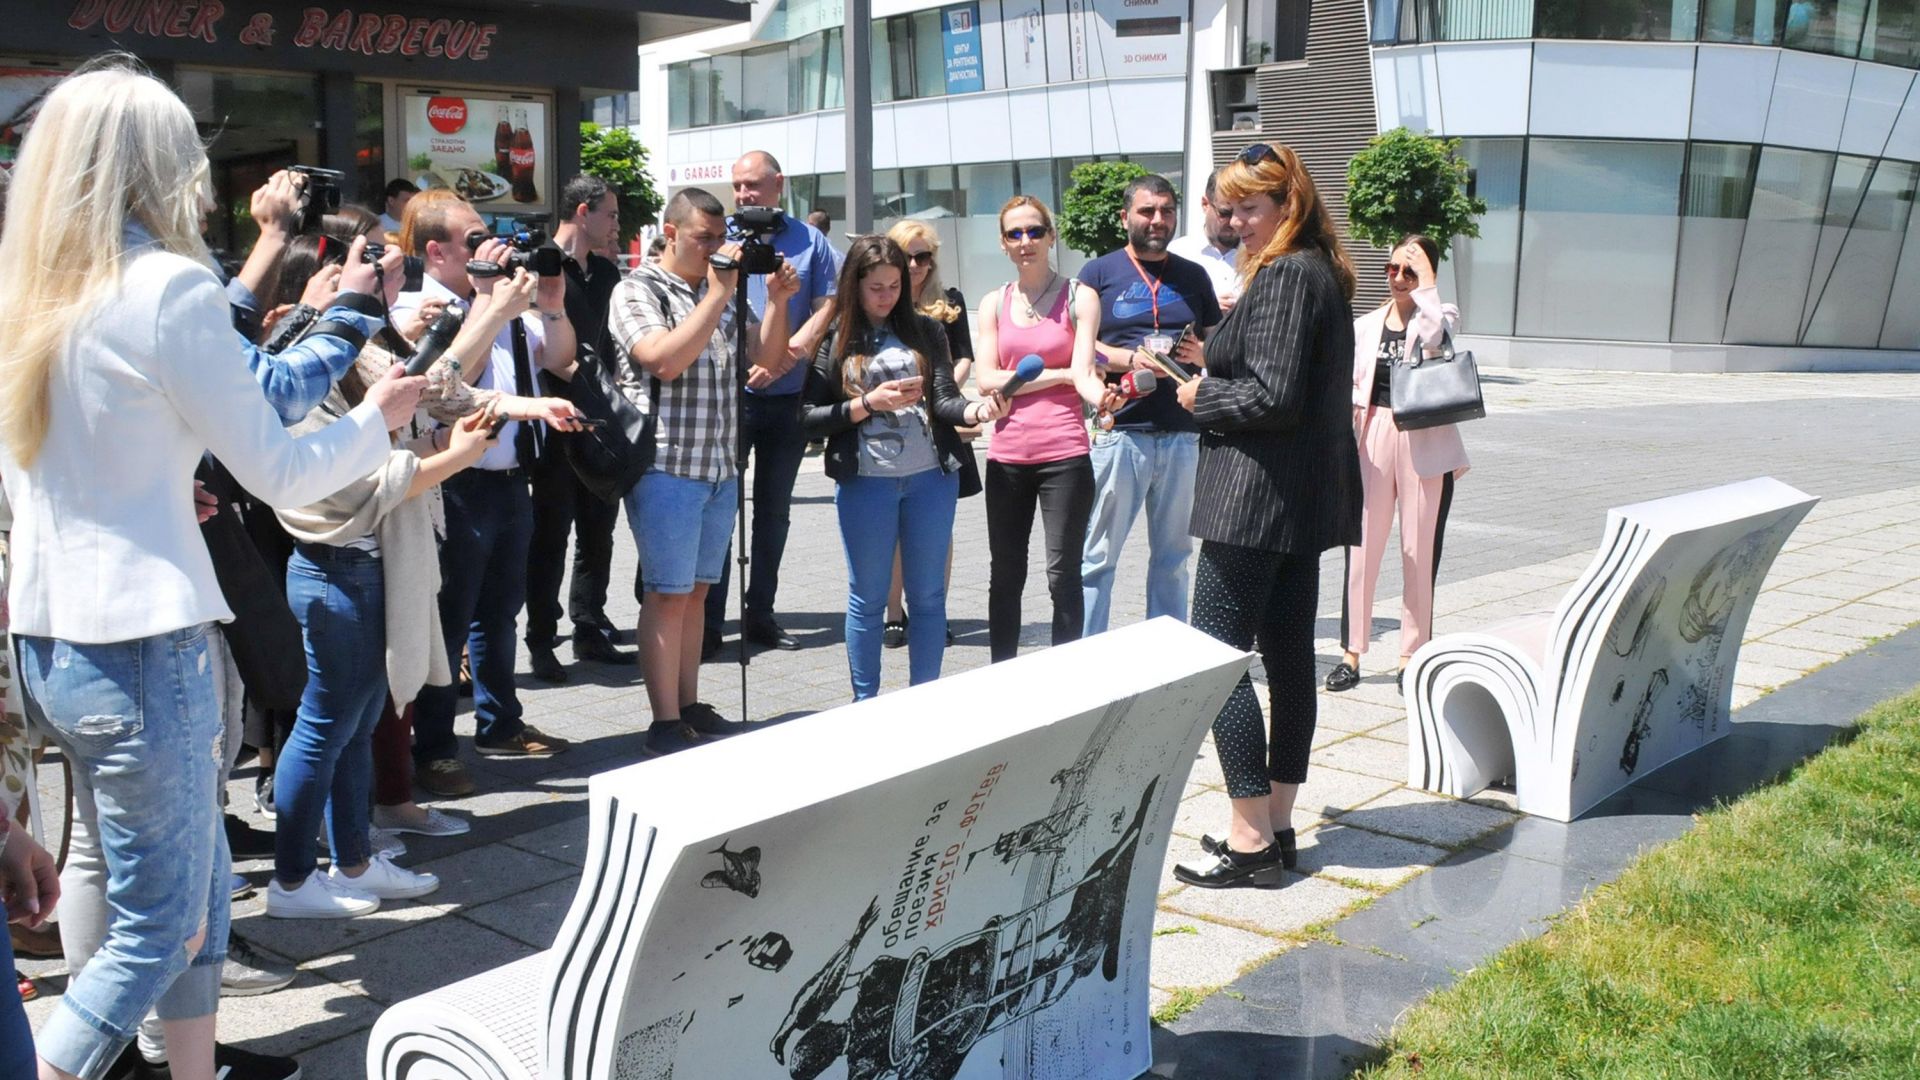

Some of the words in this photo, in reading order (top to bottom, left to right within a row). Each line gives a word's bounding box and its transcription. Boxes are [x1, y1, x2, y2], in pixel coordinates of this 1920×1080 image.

[239, 12, 276, 46] &
[293, 7, 497, 60] BARBECUE
[1134, 53, 1168, 63] СНИМКИ
[431, 145, 466, 153] ЗАЕДНО
[684, 165, 723, 181] GARAGE
[882, 834, 930, 948] обещание
[925, 799, 950, 826] за
[904, 851, 940, 940] поезия
